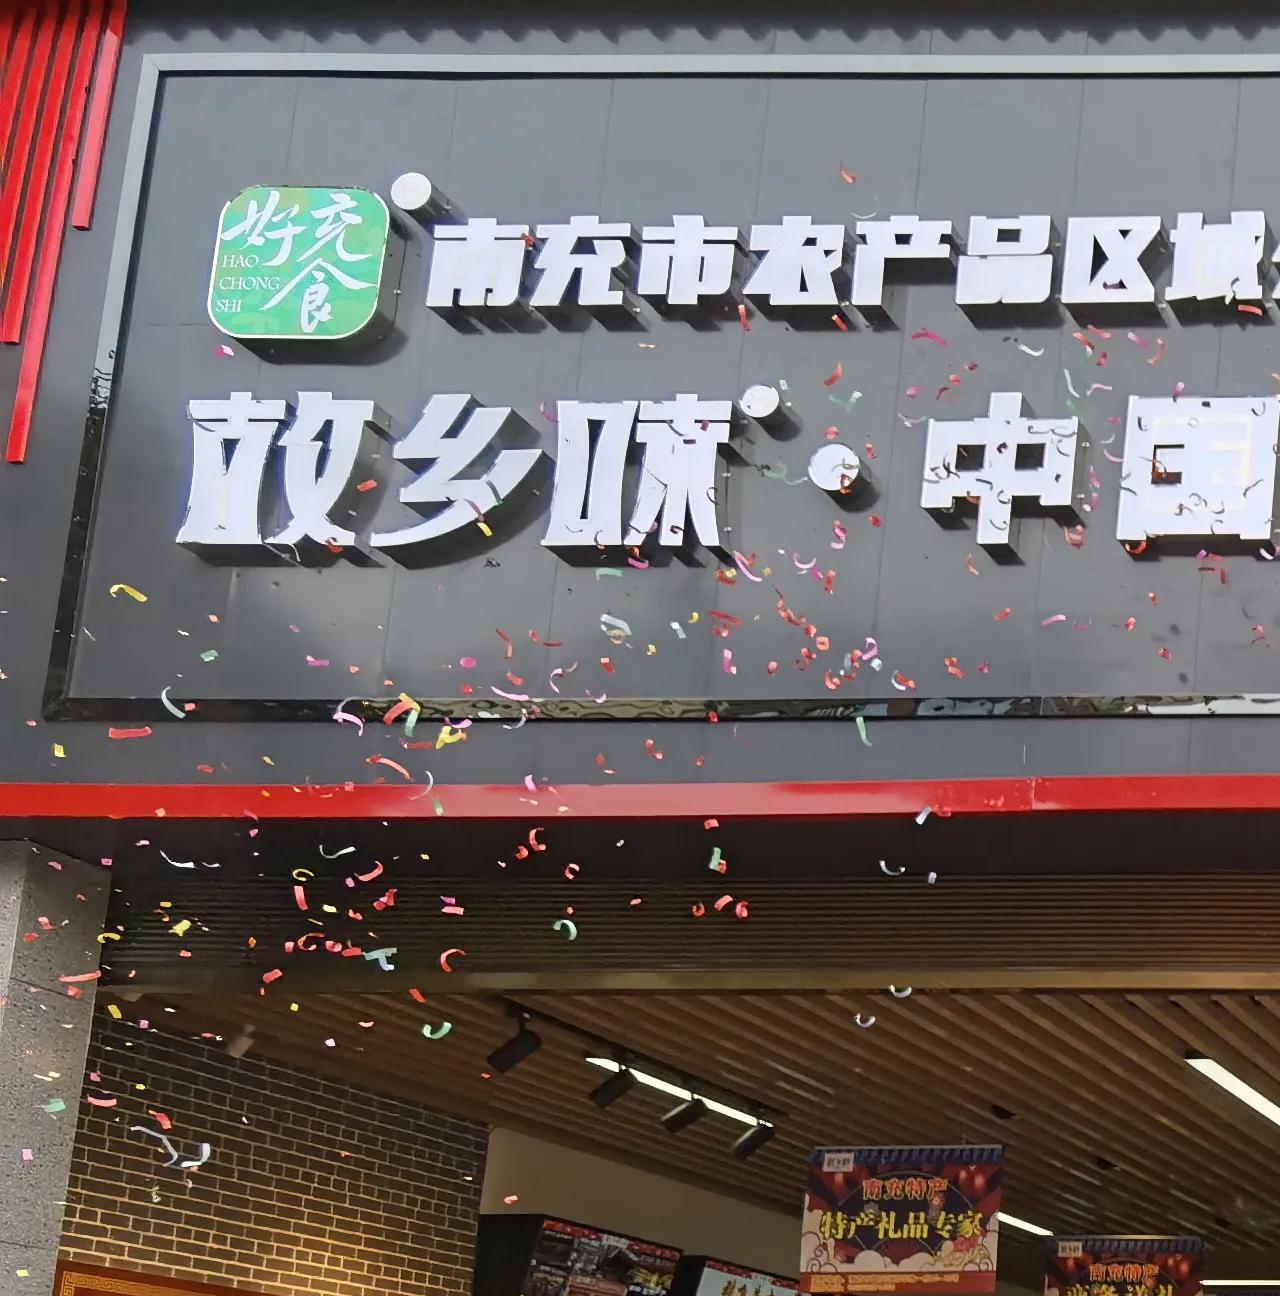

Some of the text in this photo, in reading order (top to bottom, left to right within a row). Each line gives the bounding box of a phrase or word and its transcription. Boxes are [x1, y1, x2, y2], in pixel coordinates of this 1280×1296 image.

[222, 254, 259, 269] HAO
[219, 276, 280, 291] CHONG
[216, 298, 242, 313] SHI
[820, 1209, 983, 1241] 特产礼品专家
